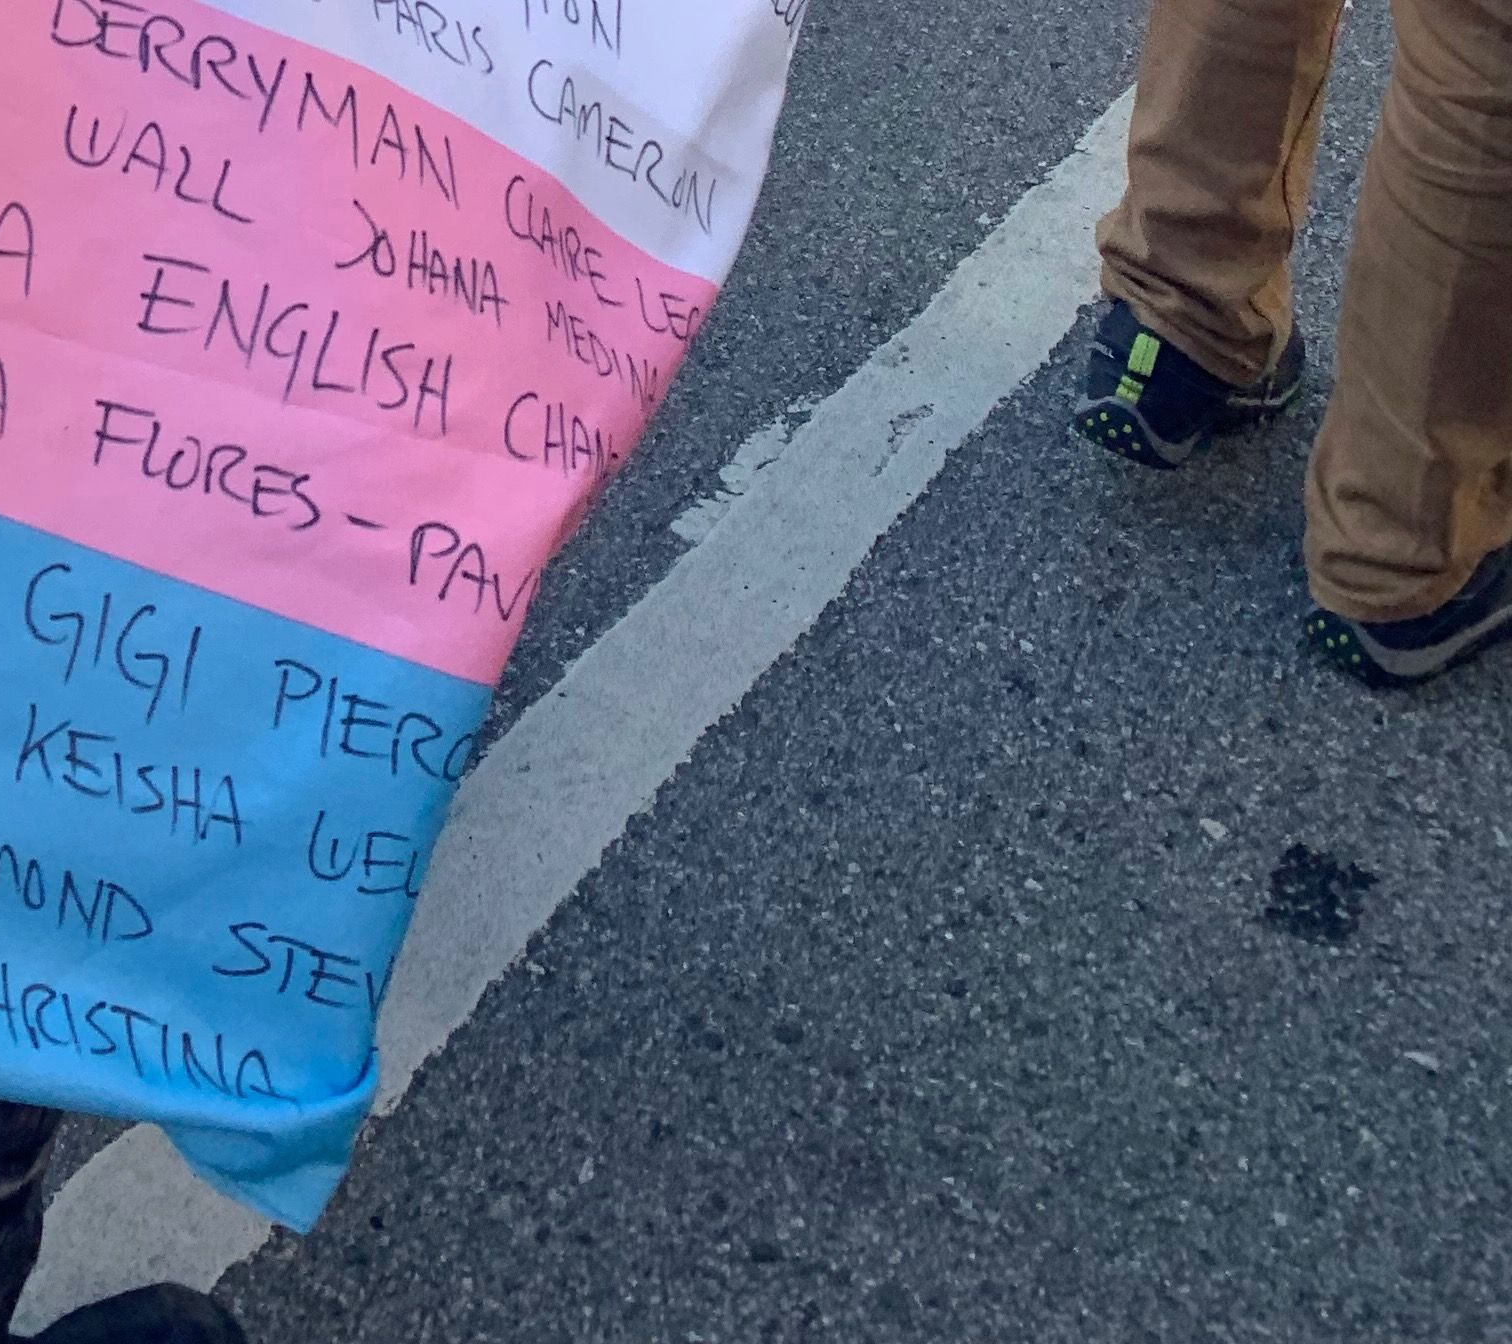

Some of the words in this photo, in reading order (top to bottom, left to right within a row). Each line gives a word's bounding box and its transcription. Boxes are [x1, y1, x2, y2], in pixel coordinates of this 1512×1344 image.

[64, 104, 255, 224] WALL
[334, 198, 511, 327] JOHANA
[527, 60, 717, 237] CAMERON
[504, 175, 626, 309] CLAIRE
[136, 254, 454, 436] ENGLISH
[25, 562, 203, 725] GIGI
[14, 703, 251, 847] KEISHA
